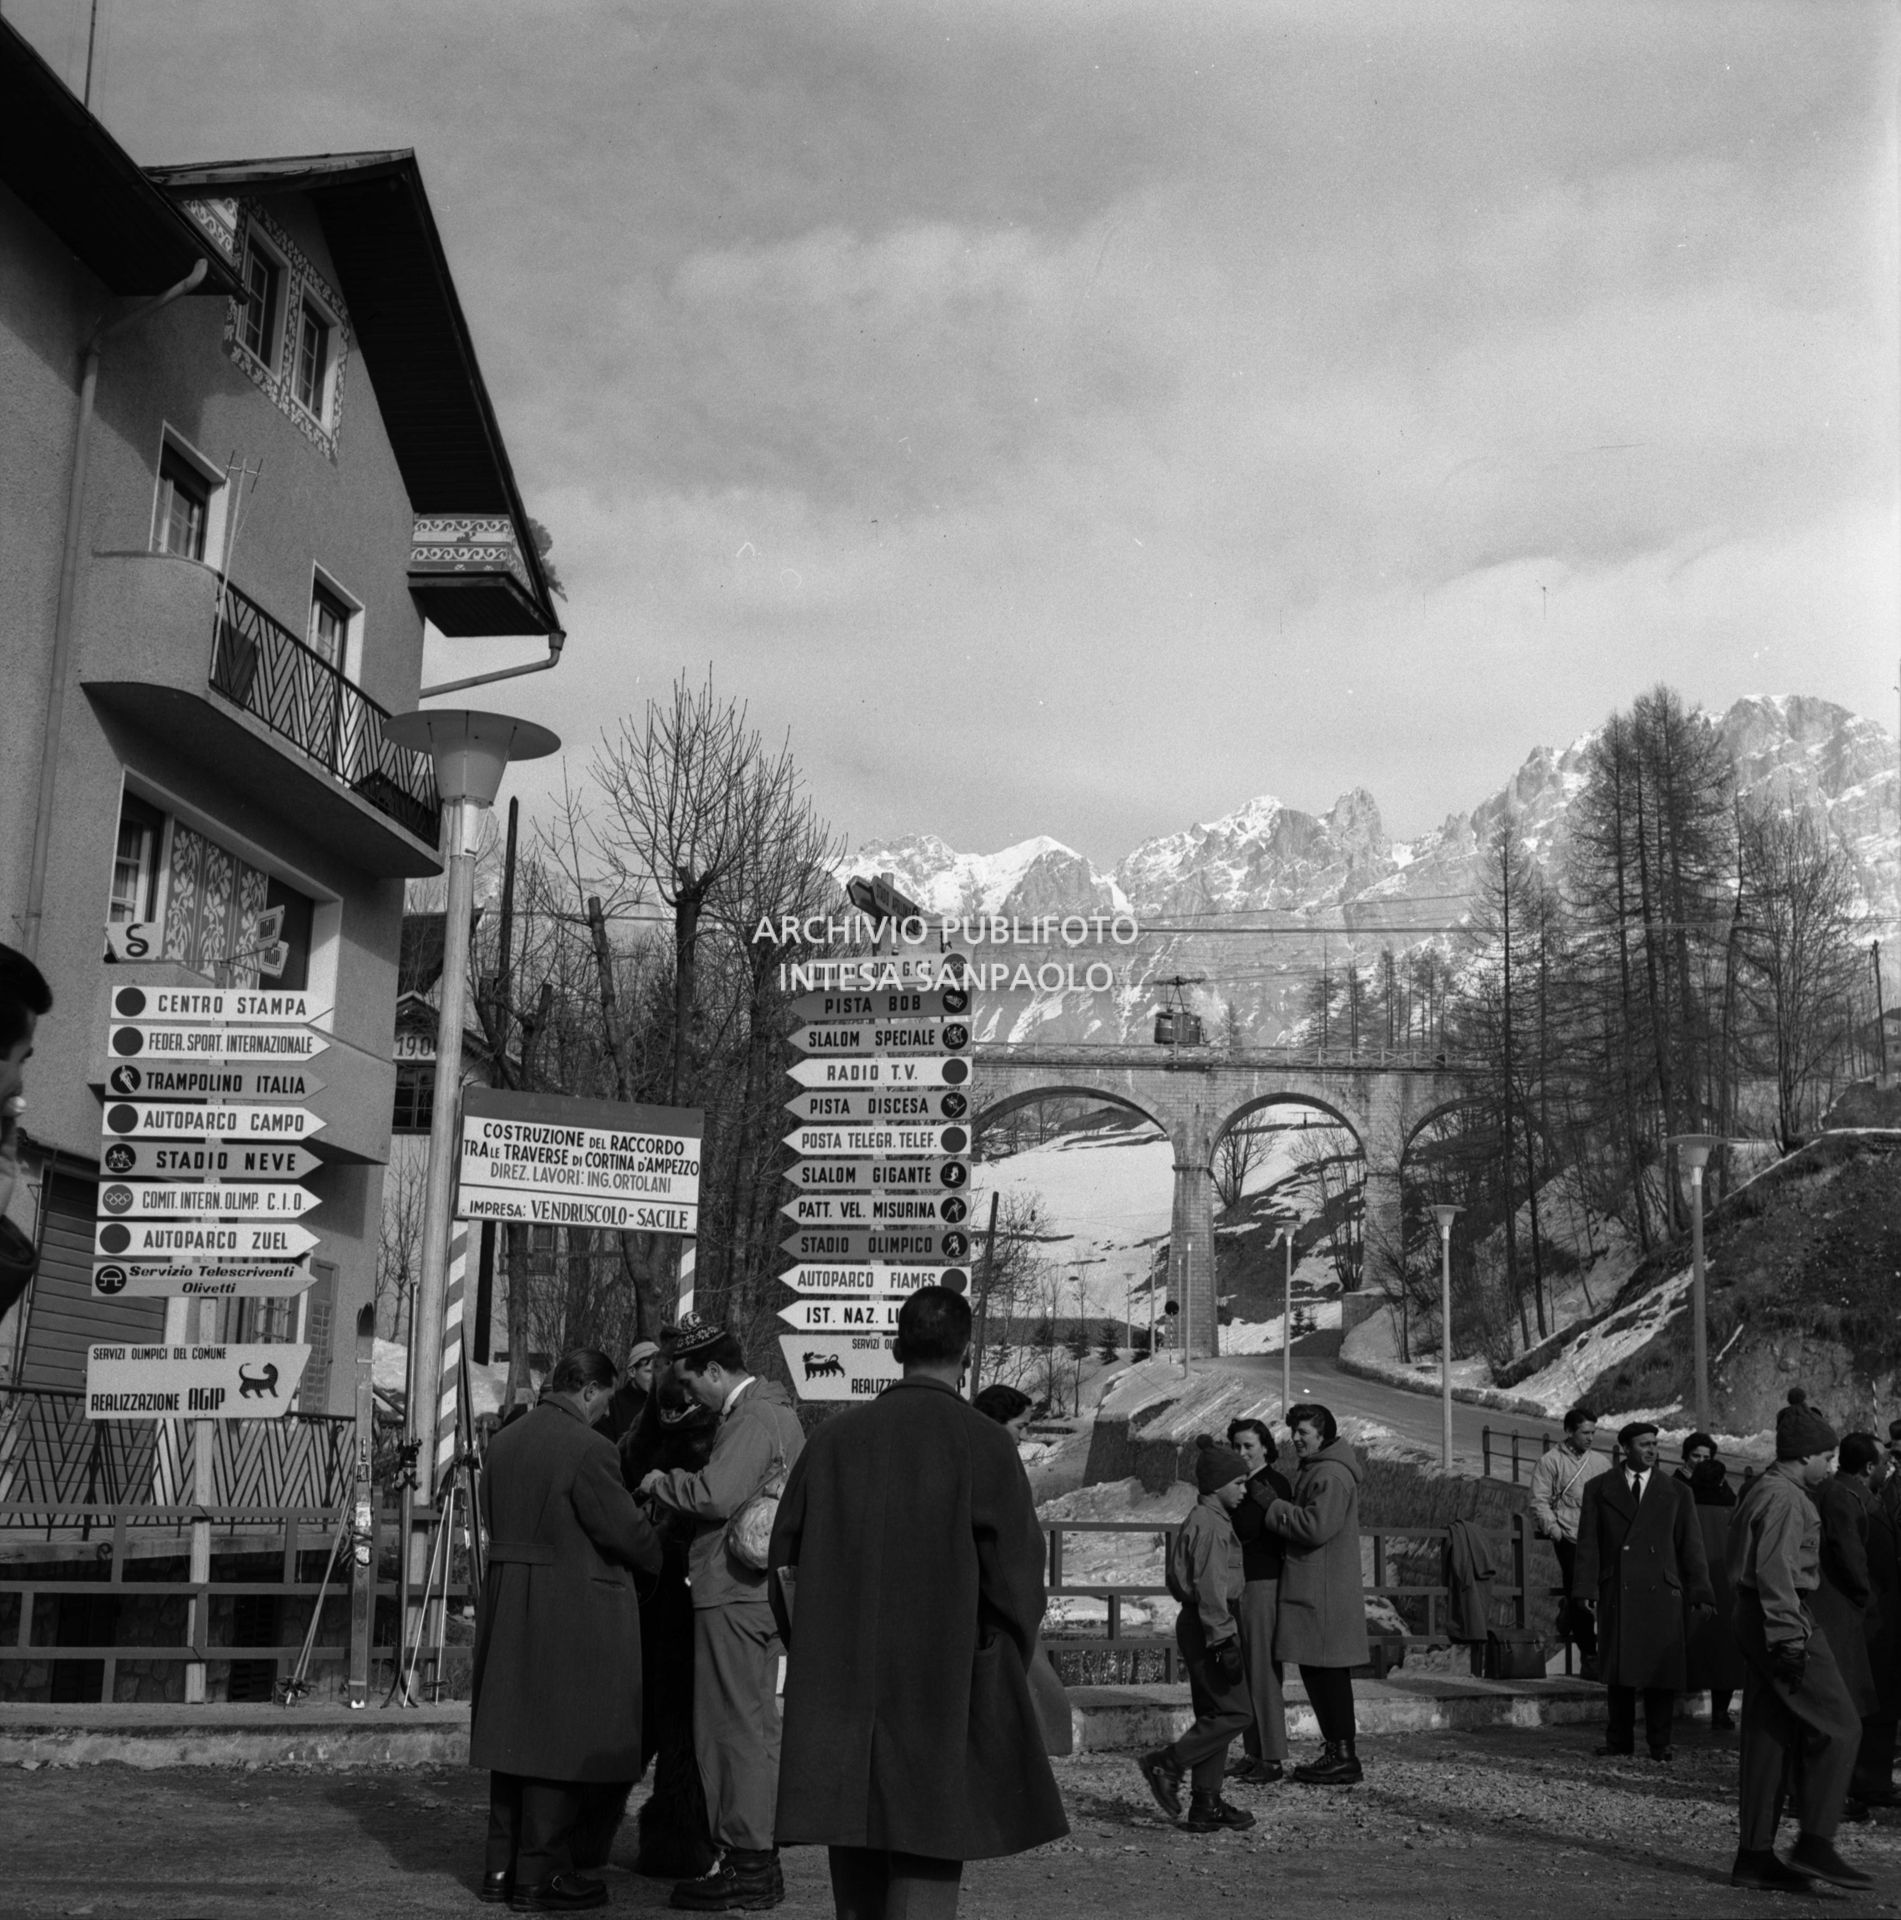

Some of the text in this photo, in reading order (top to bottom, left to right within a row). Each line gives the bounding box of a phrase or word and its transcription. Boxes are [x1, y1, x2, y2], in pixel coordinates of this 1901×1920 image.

[158, 994, 307, 1016] CENTRO STAMPA
[825, 995, 921, 1014] PISTA BOB
[149, 1033, 313, 1054] FEDER. SPORT. INTERNAZIONALE
[809, 1029, 935, 1047] SLALOM SPECIALE
[827, 1064, 918, 1081] RADIO T.V.
[146, 1072, 306, 1094] TRAMPOLINO ITALIA
[810, 1098, 928, 1114] PISTA DISCESA
[144, 1111, 304, 1132] AUTOPARCO CAMPO
[483, 1123, 584, 1147] COSTRUZIONE
[611, 1135, 684, 1156] RACCORDO
[802, 1133, 937, 1149] POSTA TELEGR. TELEF.
[156, 1151, 296, 1170] STADIO NEVE
[464, 1140, 488, 1157] TRA
[504, 1144, 568, 1165] TRAVERSE
[585, 1152, 634, 1172] CORTINA
[490, 1162, 671, 1193] DIREZ. LAVORI: ING. ORTOLANI
[802, 1167, 932, 1183] SLALOM GIGANTE
[142, 1191, 178, 1209] COMIT.
[180, 1191, 223, 1210] INTERN.
[224, 1192, 259, 1210] OLIMP.
[470, 1200, 526, 1217] IMPRESA:
[531, 1200, 627, 1225] VENDRUSCOLO
[636, 1208, 688, 1230] SACILE
[798, 1202, 935, 1218] PATT. VEL. MISURINA
[143, 1231, 288, 1250] AUTOPARCO ZUEL
[801, 1237, 932, 1253] STADIO OLIMPICO
[129, 1266, 294, 1277] Servizio Telescriventi
[797, 1271, 935, 1288] AUTOPARCO FIAMES
[182, 1282, 236, 1293] Olivetti
[806, 1307, 835, 1323] IST.
[844, 1307, 878, 1323] NAZ.
[852, 1339, 880, 1350] SERVIZI
[93, 1348, 226, 1360] SERVIZI OLIMPICI DEL COMUNE
[91, 1388, 226, 1411] REALIZZAZIONE AGIP
